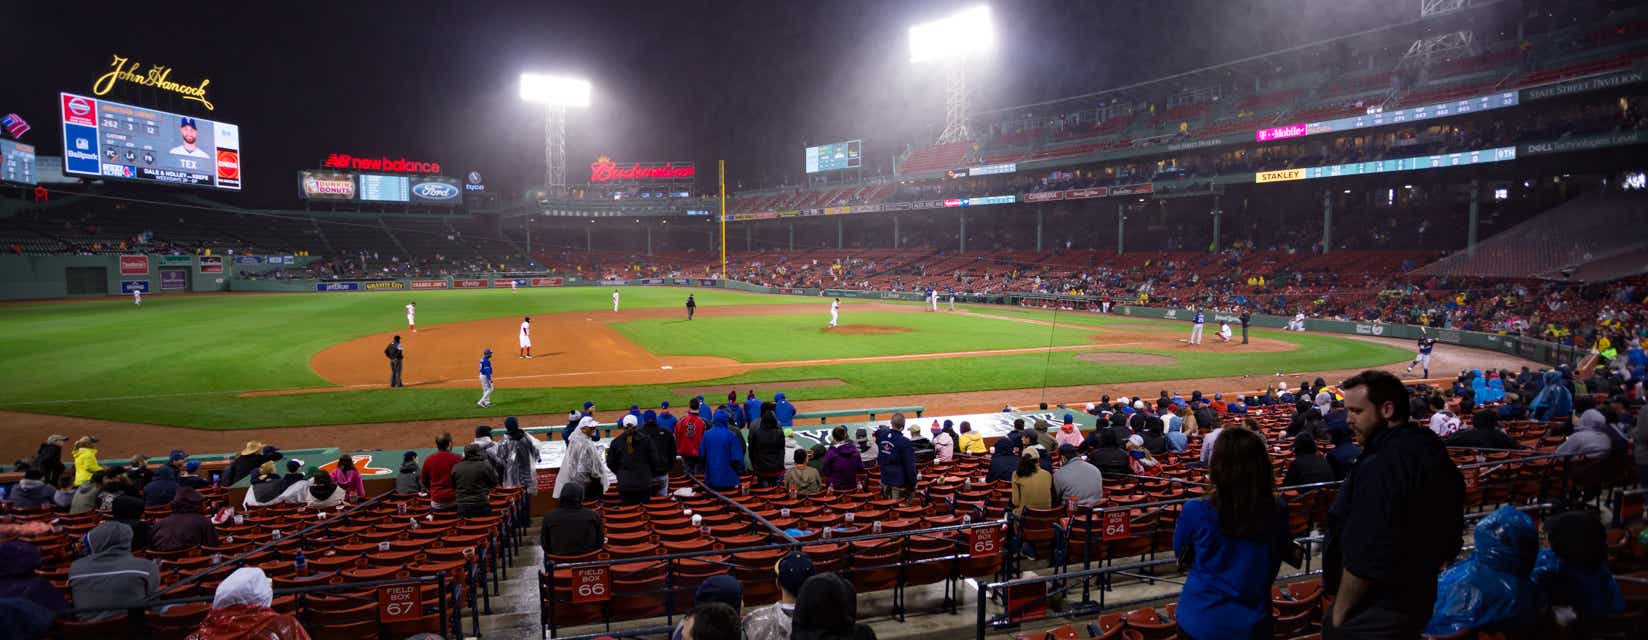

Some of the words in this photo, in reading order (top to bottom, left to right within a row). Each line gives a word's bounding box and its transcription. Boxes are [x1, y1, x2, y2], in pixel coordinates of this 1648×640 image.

[93, 55, 145, 97] John
[145, 64, 214, 111] Hancock
[1528, 144, 1553, 153] DELL
[180, 159, 198, 170] TEX
[352, 158, 381, 170] new
[382, 157, 440, 173] balance
[165, 170, 187, 178] HOLLEY
[591, 161, 695, 182] Budweiser
[1261, 170, 1300, 181] STANLEY
[319, 186, 351, 194] DONUTS
[422, 185, 449, 197] Ford
[1106, 524, 1124, 536] 64
[974, 540, 994, 552] 65
[579, 568, 604, 577] FIELD
[387, 586, 414, 595] FIELD
[578, 583, 605, 596] 66
[391, 593, 410, 601] BOX
[386, 601, 414, 615] 67
